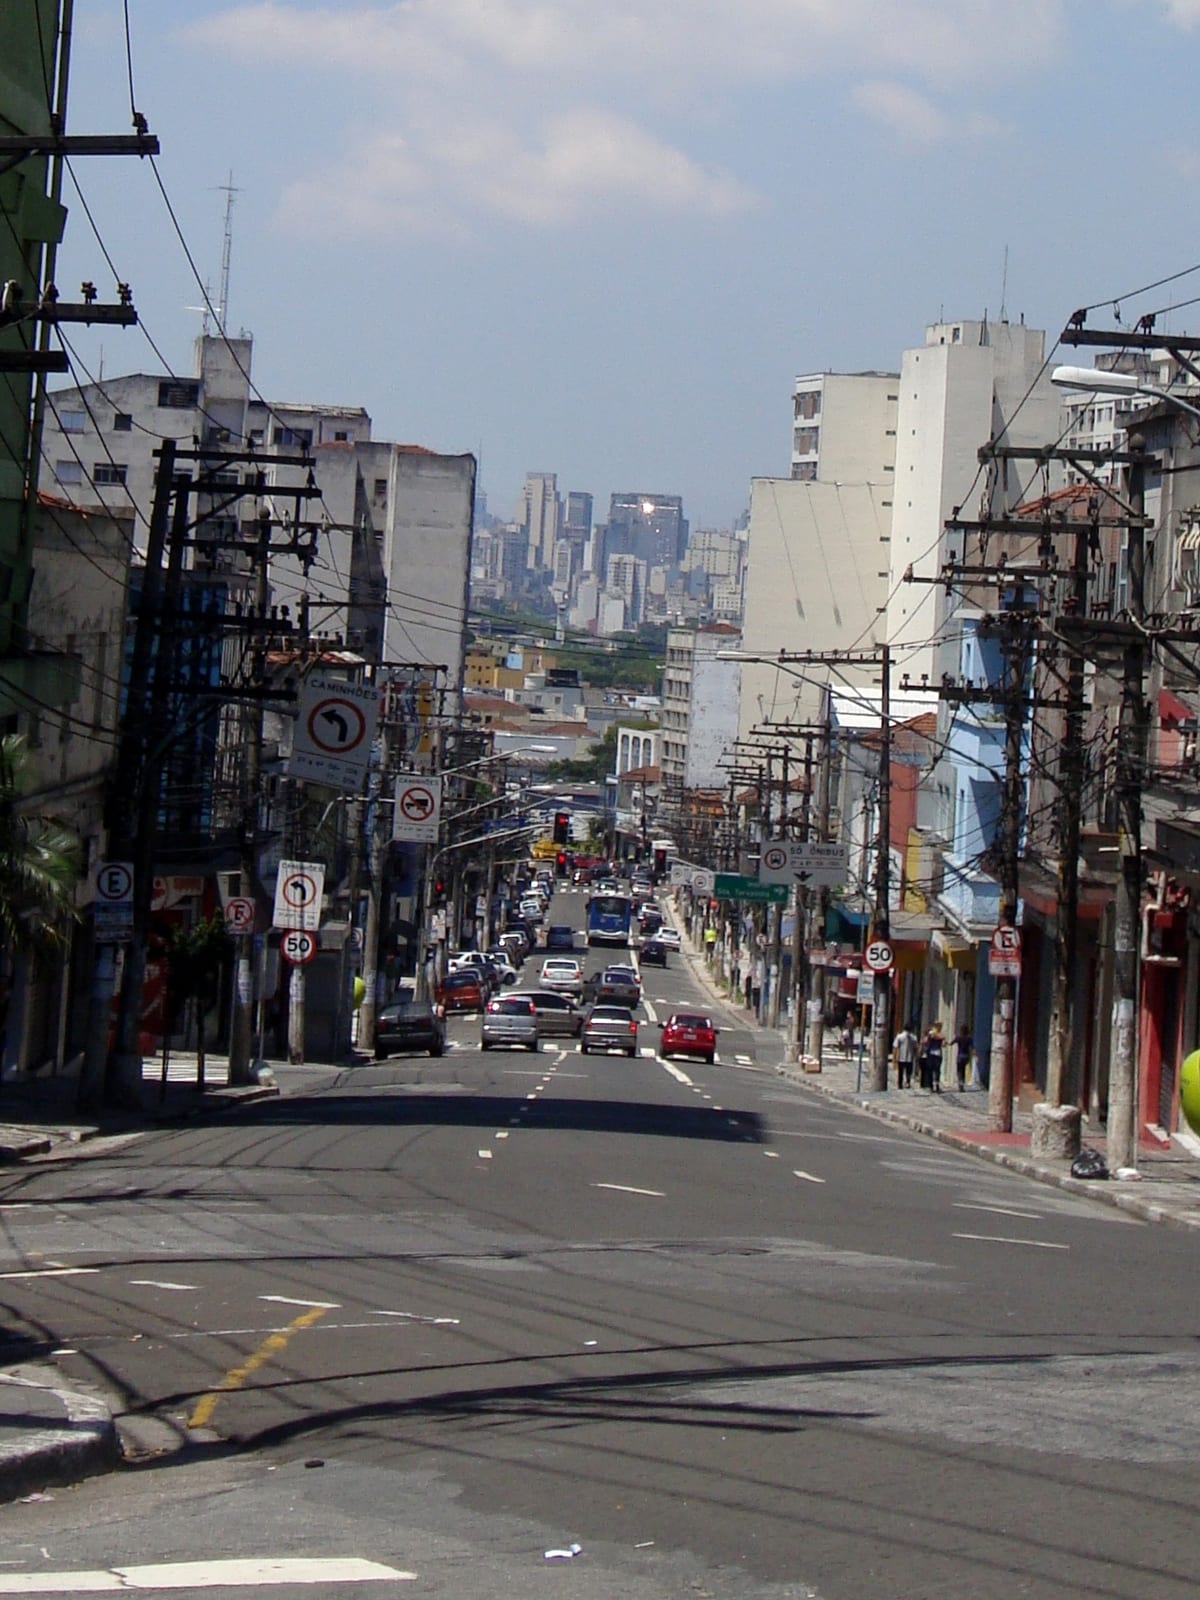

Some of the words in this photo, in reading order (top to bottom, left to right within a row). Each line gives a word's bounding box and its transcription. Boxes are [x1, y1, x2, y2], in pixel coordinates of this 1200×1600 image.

[311, 679, 378, 701] CAMINHÕES
[790, 845, 802, 855] SÓ
[810, 844, 845, 857] ÔNIBUS
[108, 871, 120, 893] E
[287, 937, 310, 952] 50
[870, 947, 891, 962] 50
